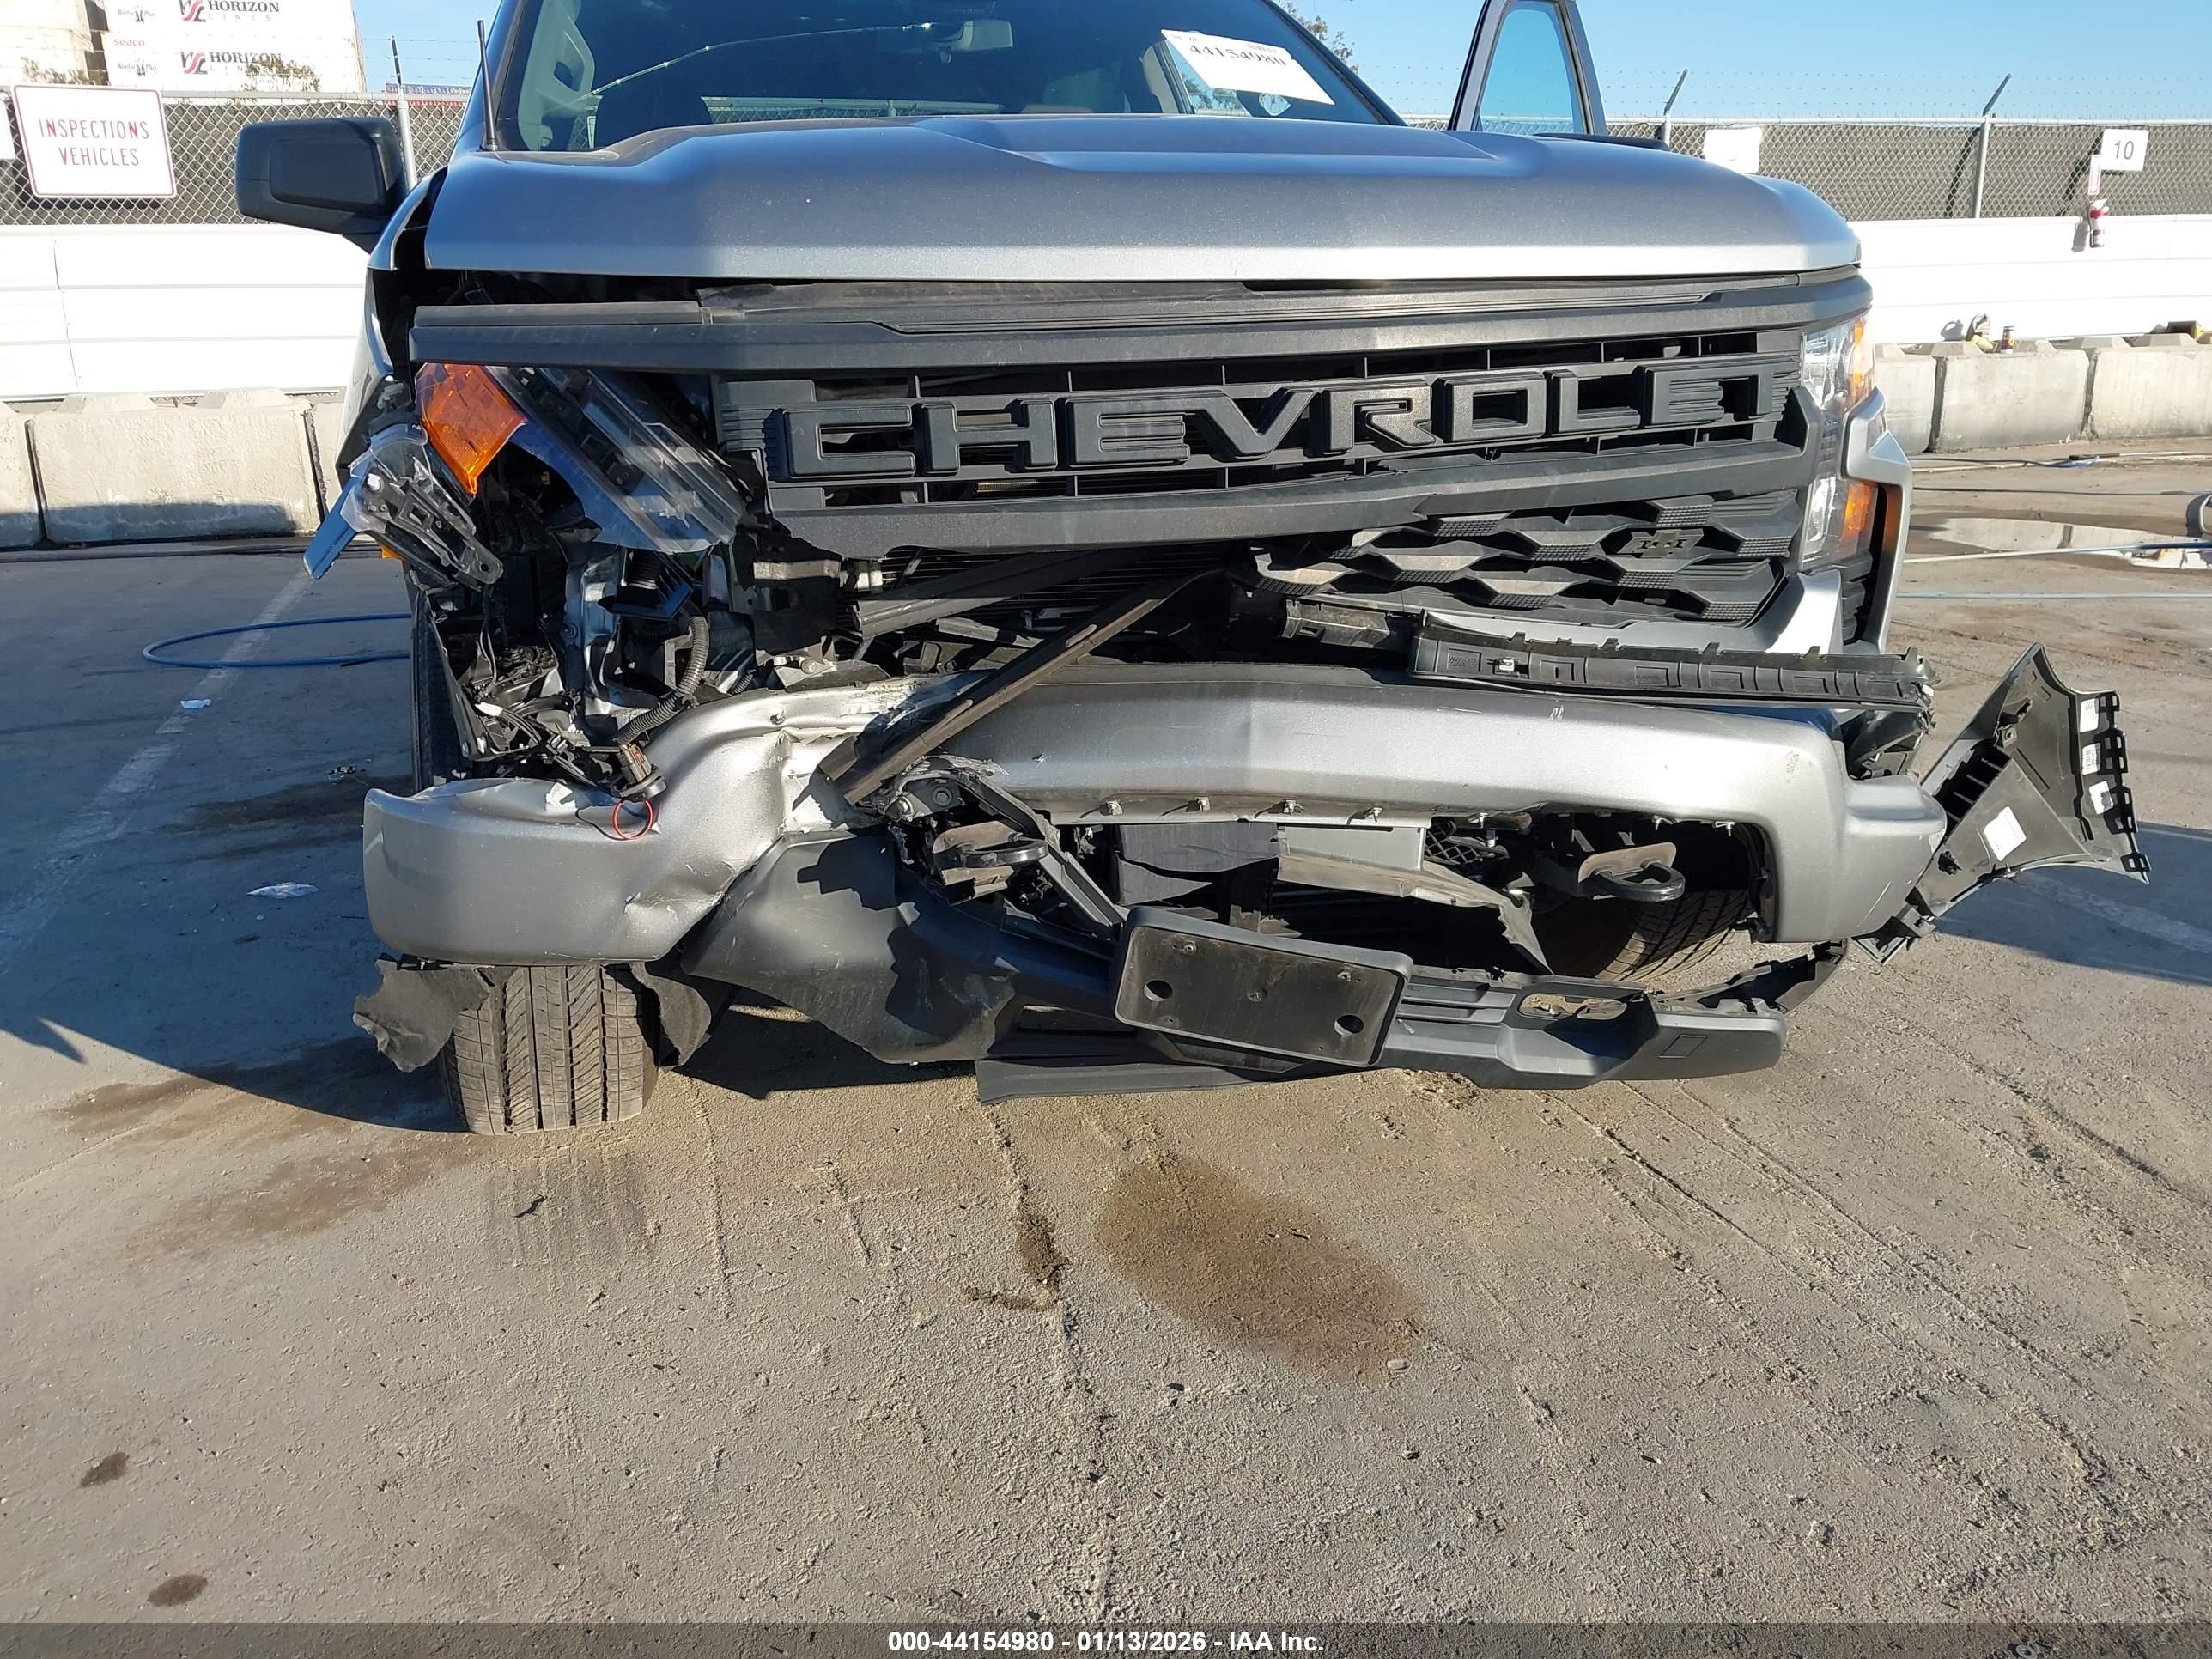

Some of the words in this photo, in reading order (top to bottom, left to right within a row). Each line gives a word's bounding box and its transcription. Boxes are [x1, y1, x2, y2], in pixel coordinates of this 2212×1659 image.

[208, 0, 279, 12] HORIZON
[209, 52, 282, 65] HORIZON
[39, 118, 149, 140] INSPECTIONS
[58, 147, 139, 167] VEHICLES
[2114, 140, 2135, 160] 10
[783, 355, 1798, 478] CHEVROLET
